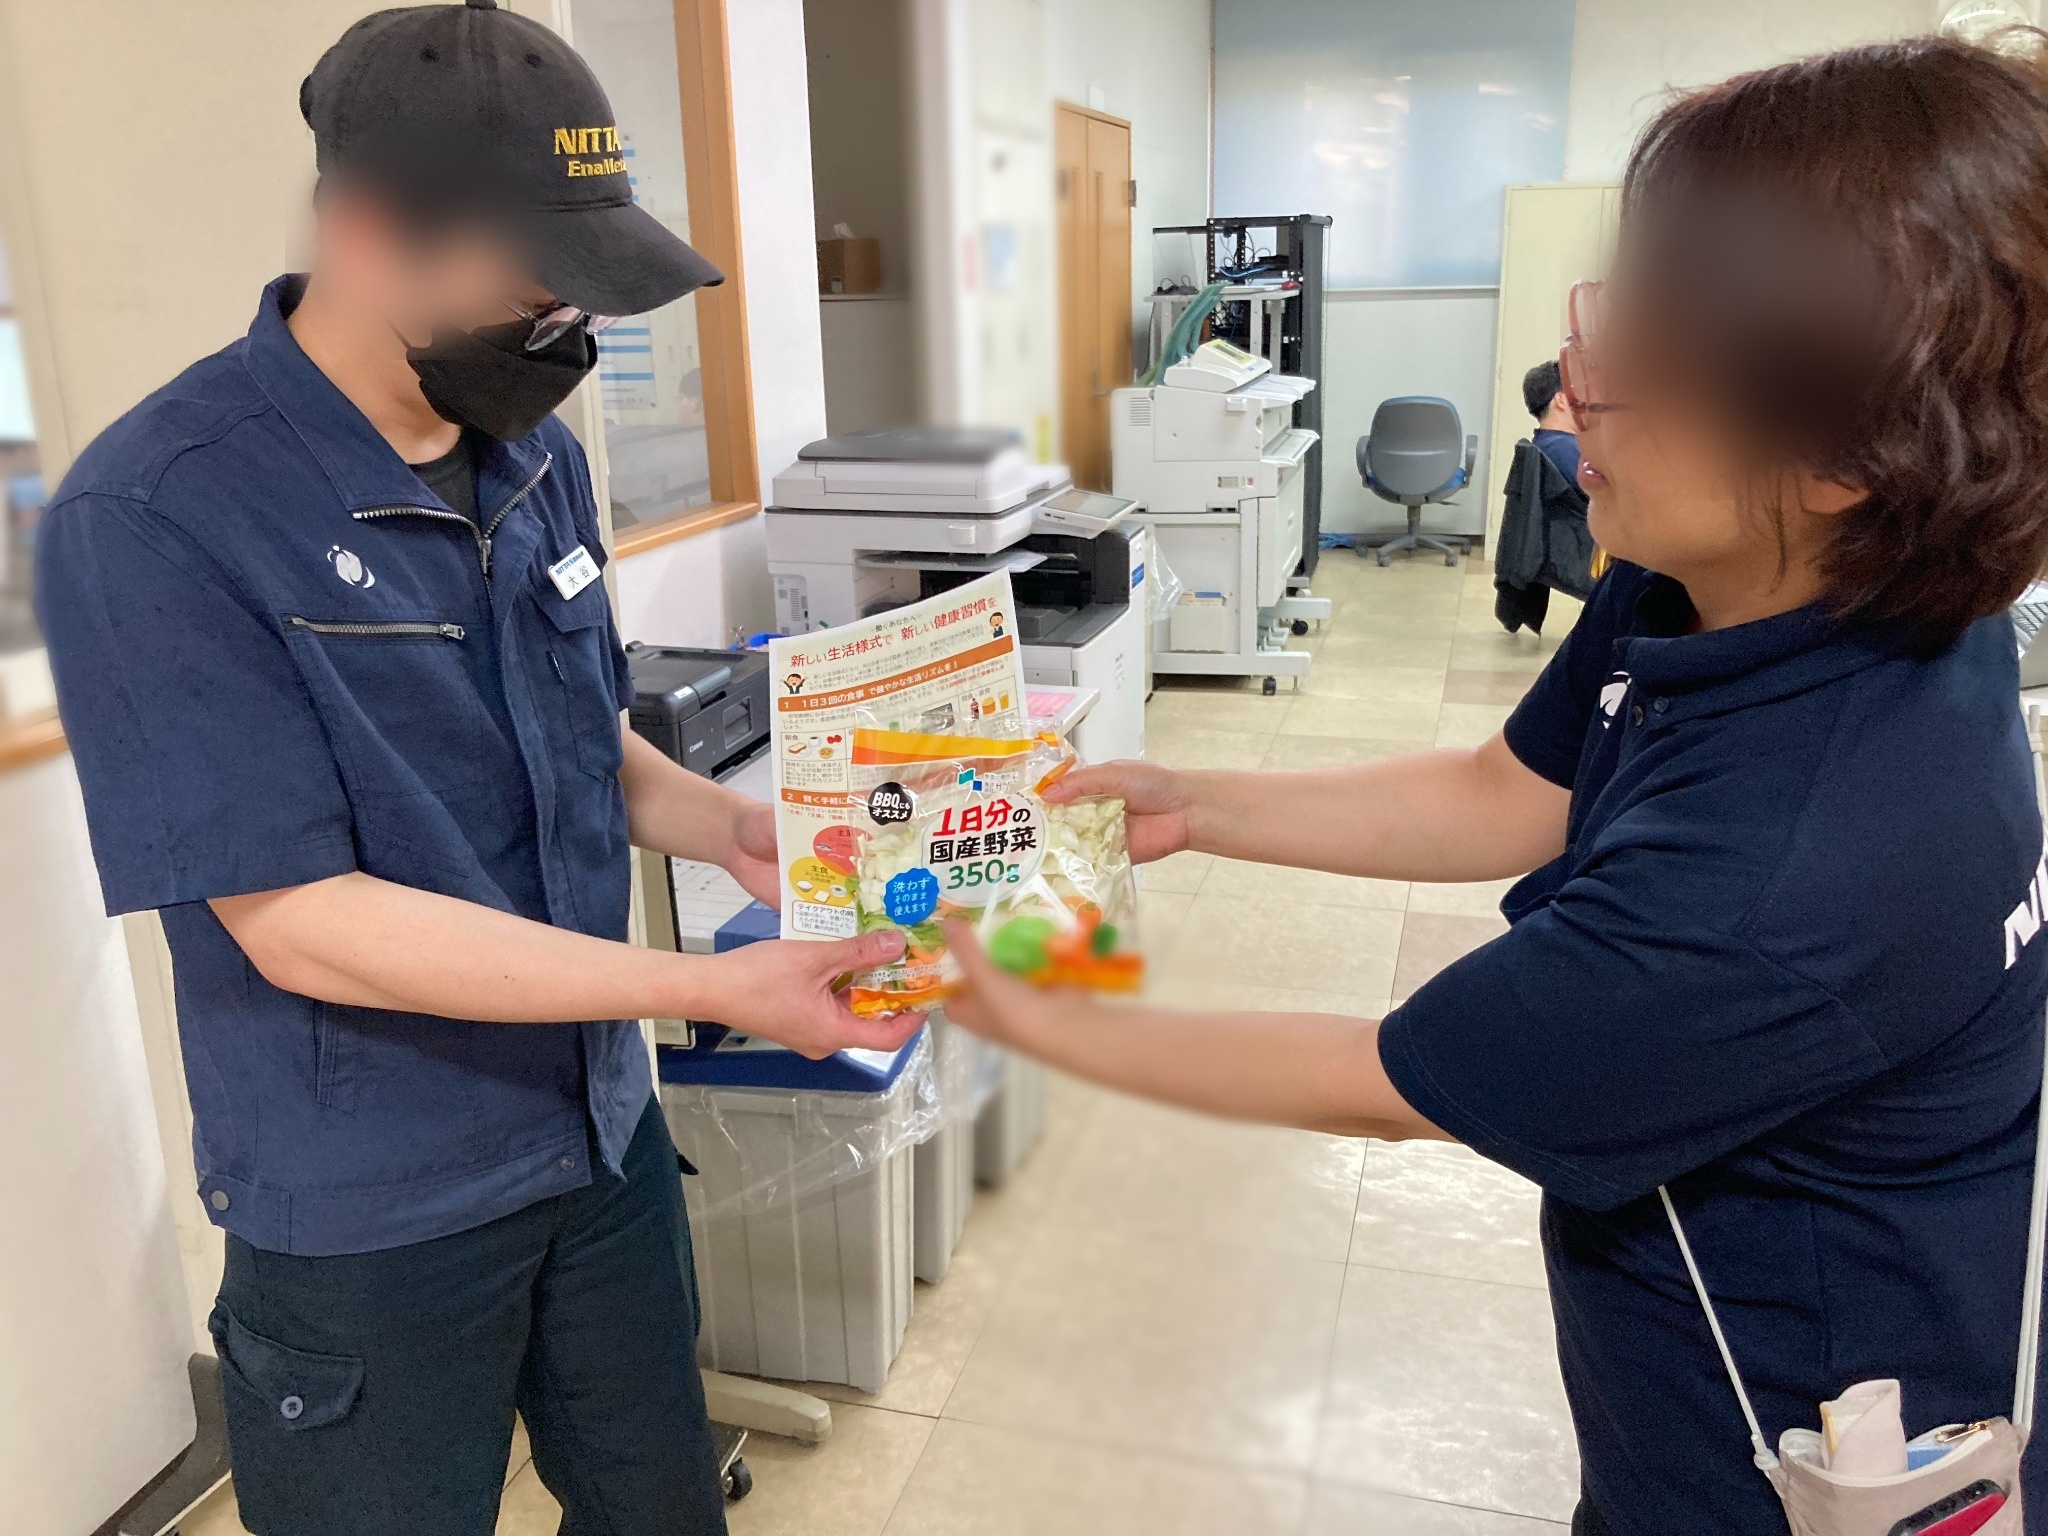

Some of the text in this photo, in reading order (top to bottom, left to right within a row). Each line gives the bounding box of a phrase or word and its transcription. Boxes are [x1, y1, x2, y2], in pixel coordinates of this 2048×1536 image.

[790, 633, 893, 668] 新しい生活様式で
[901, 597, 998, 641] 新しい健康習慣を
[783, 701, 790, 709] 1
[801, 689, 865, 709] 1日3回の食事
[872, 808, 908, 820] オススメ
[933, 798, 1031, 837] 1日分の
[929, 826, 1037, 864] 国産野菜
[811, 865, 829, 875] 主食
[946, 859, 1020, 890] 350g
[893, 877, 931, 893] 洗わず
[894, 891, 928, 904] そのまま
[894, 902, 929, 917] 使えます
